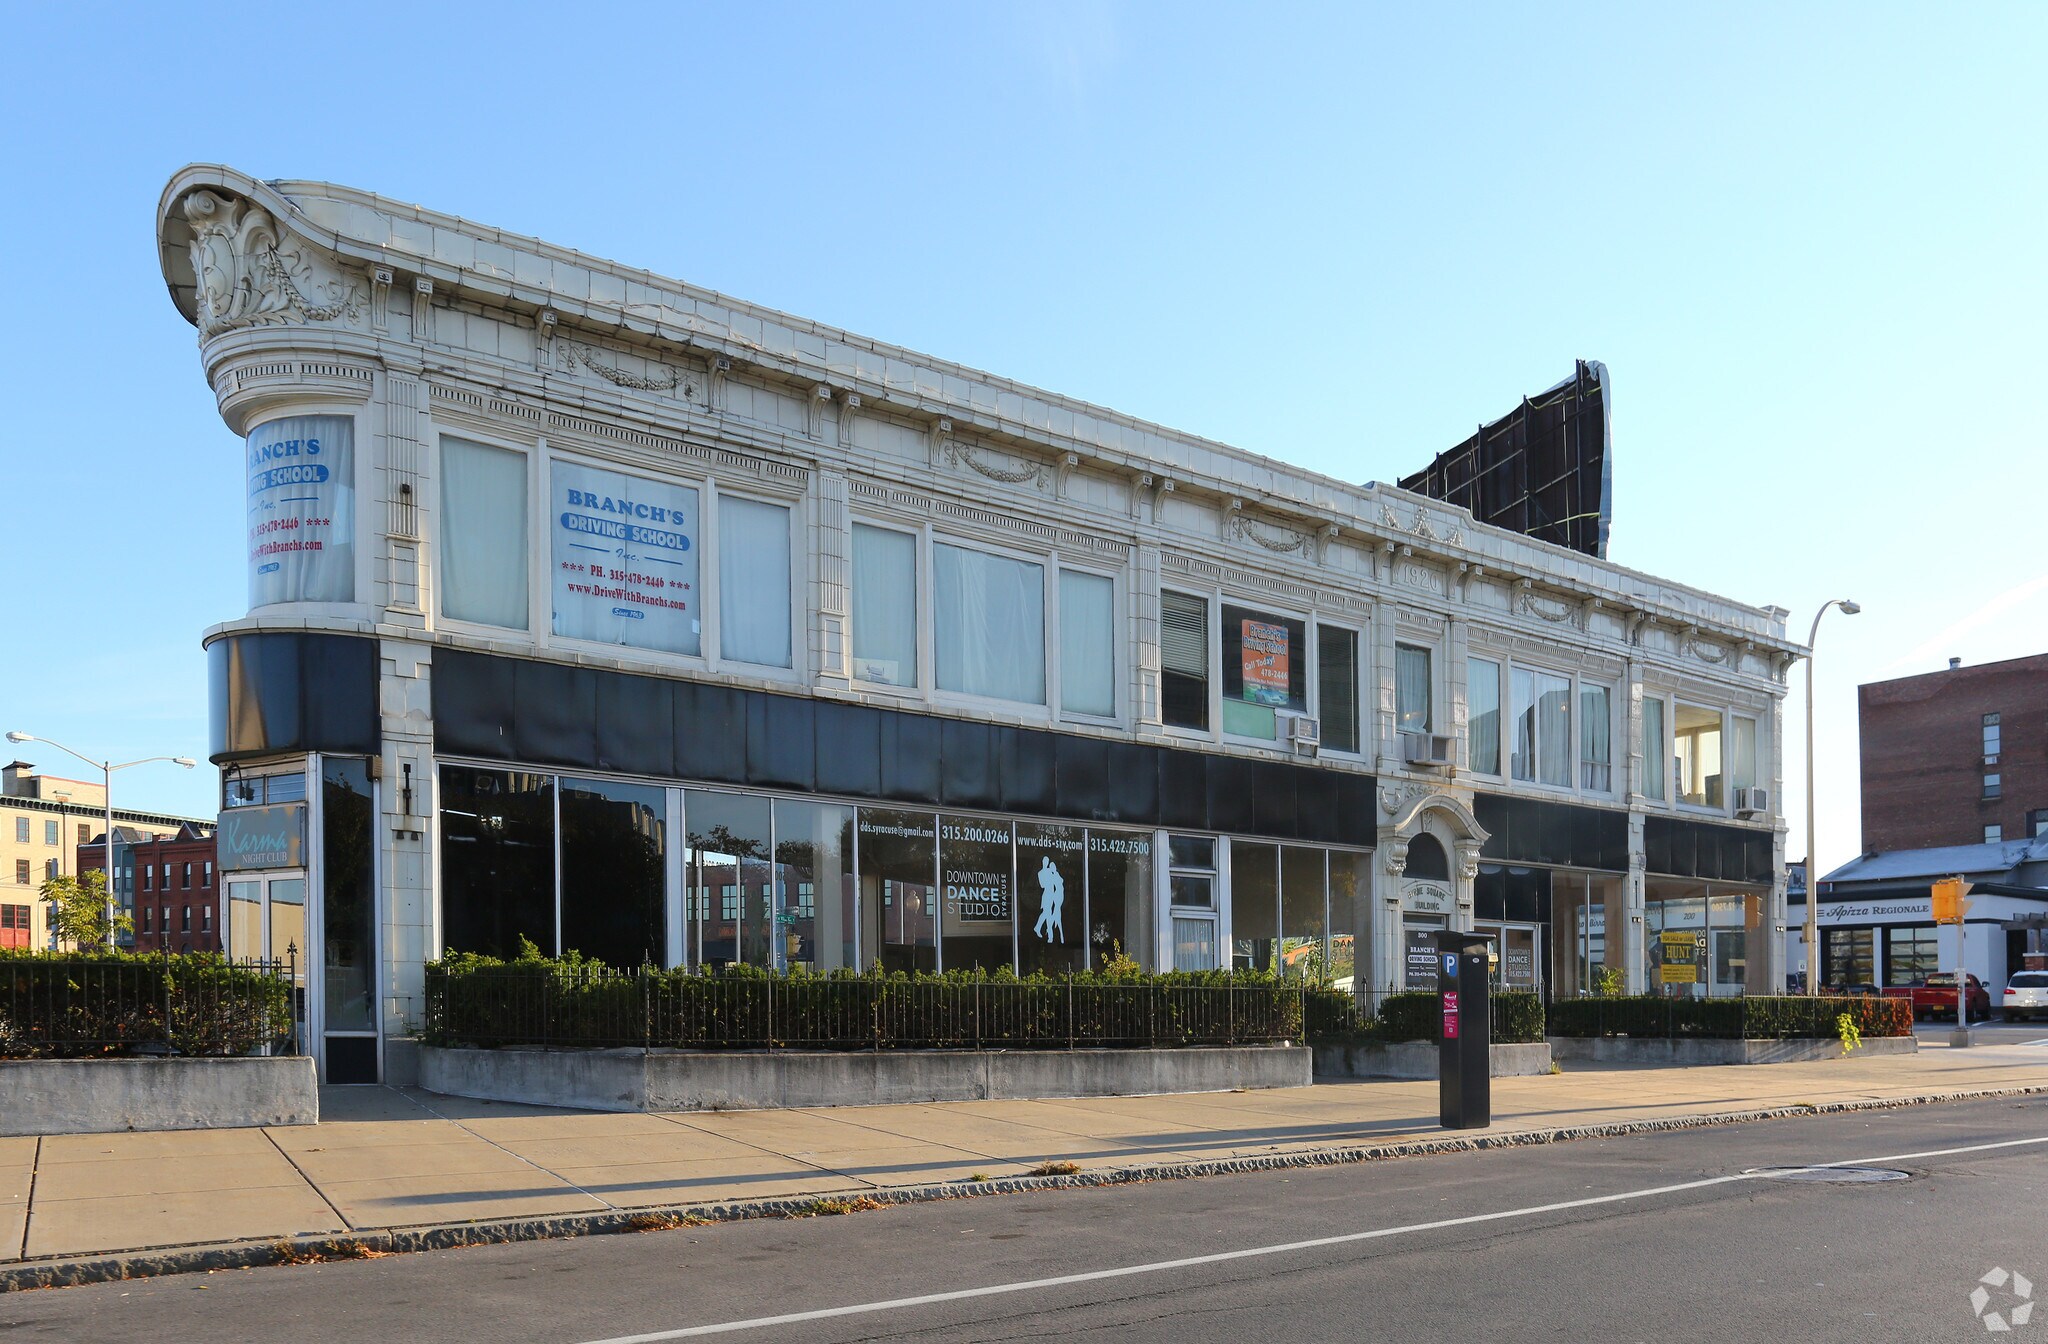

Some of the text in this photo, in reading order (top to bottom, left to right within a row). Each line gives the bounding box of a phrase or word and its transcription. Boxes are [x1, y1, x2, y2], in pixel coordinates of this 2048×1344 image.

[271, 466, 320, 485] SCHOOL
[567, 488, 685, 525] BRANCH'S
[568, 514, 683, 549] DRIVING SCHOOL
[615, 548, 640, 562] Inc.
[590, 564, 664, 588] PH. 315-478-2446
[1404, 564, 1437, 591] 1920
[567, 583, 686, 610] www.DriveWithBranchs.com
[1243, 635, 1287, 656] Driving School
[1244, 661, 1255, 670] Call
[228, 817, 288, 854] Karma
[860, 821, 934, 839] dds.syracuse@gmail.com
[942, 825, 1009, 844] 315.200.0266
[1090, 838, 1149, 855] 315.422.7500
[242, 851, 288, 864] NIGHT CLUB
[946, 870, 999, 885] DOWNTOWN
[946, 886, 999, 902] DANCE
[947, 902, 1000, 917] STUDIO
[1415, 901, 1440, 911] BUILDING
[1826, 905, 1929, 921] Apizza REGIONALE
[1683, 912, 1696, 921] 200
[1665, 945, 1691, 958] HUNT
[1446, 956, 1455, 973] P
